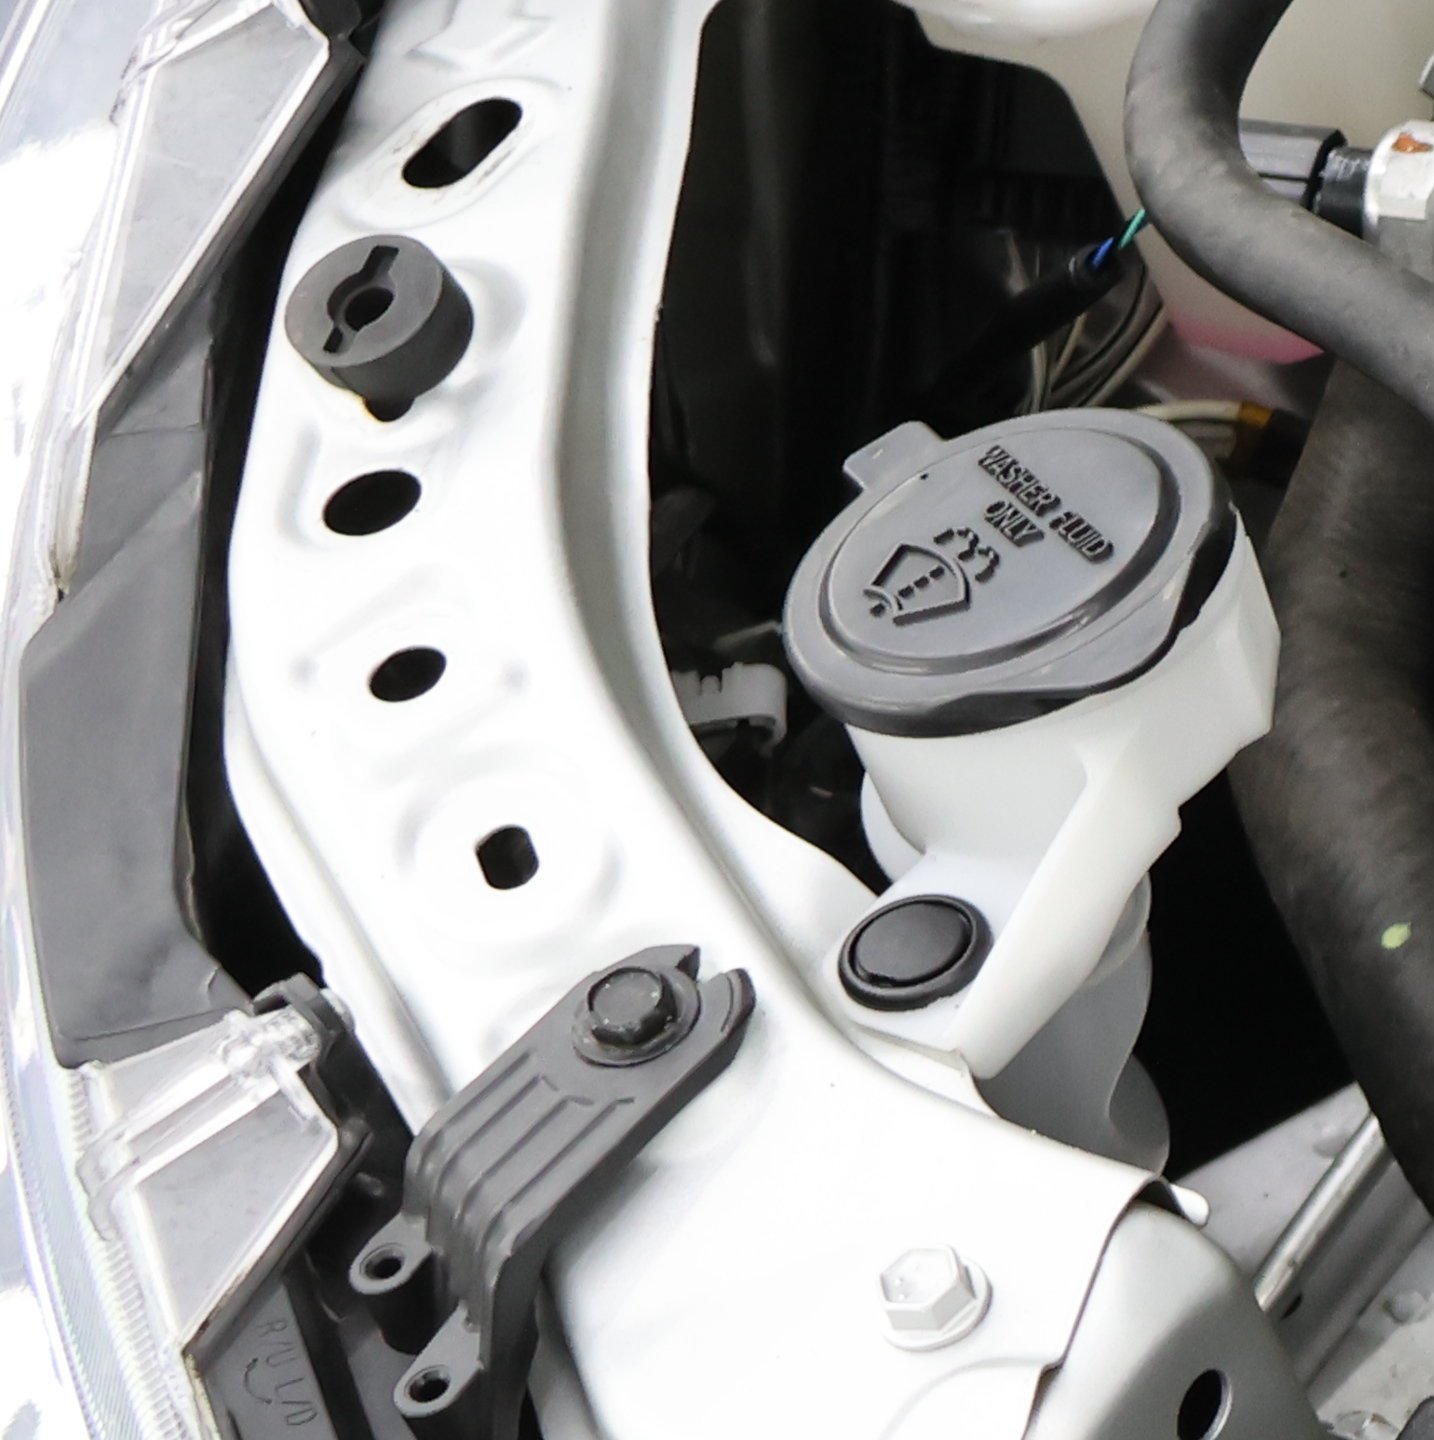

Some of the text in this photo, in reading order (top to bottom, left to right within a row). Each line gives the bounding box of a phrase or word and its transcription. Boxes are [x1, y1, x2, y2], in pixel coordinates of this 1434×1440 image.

[978, 445, 1115, 565] WASHER FLUID
[984, 500, 1046, 548] ONLY
